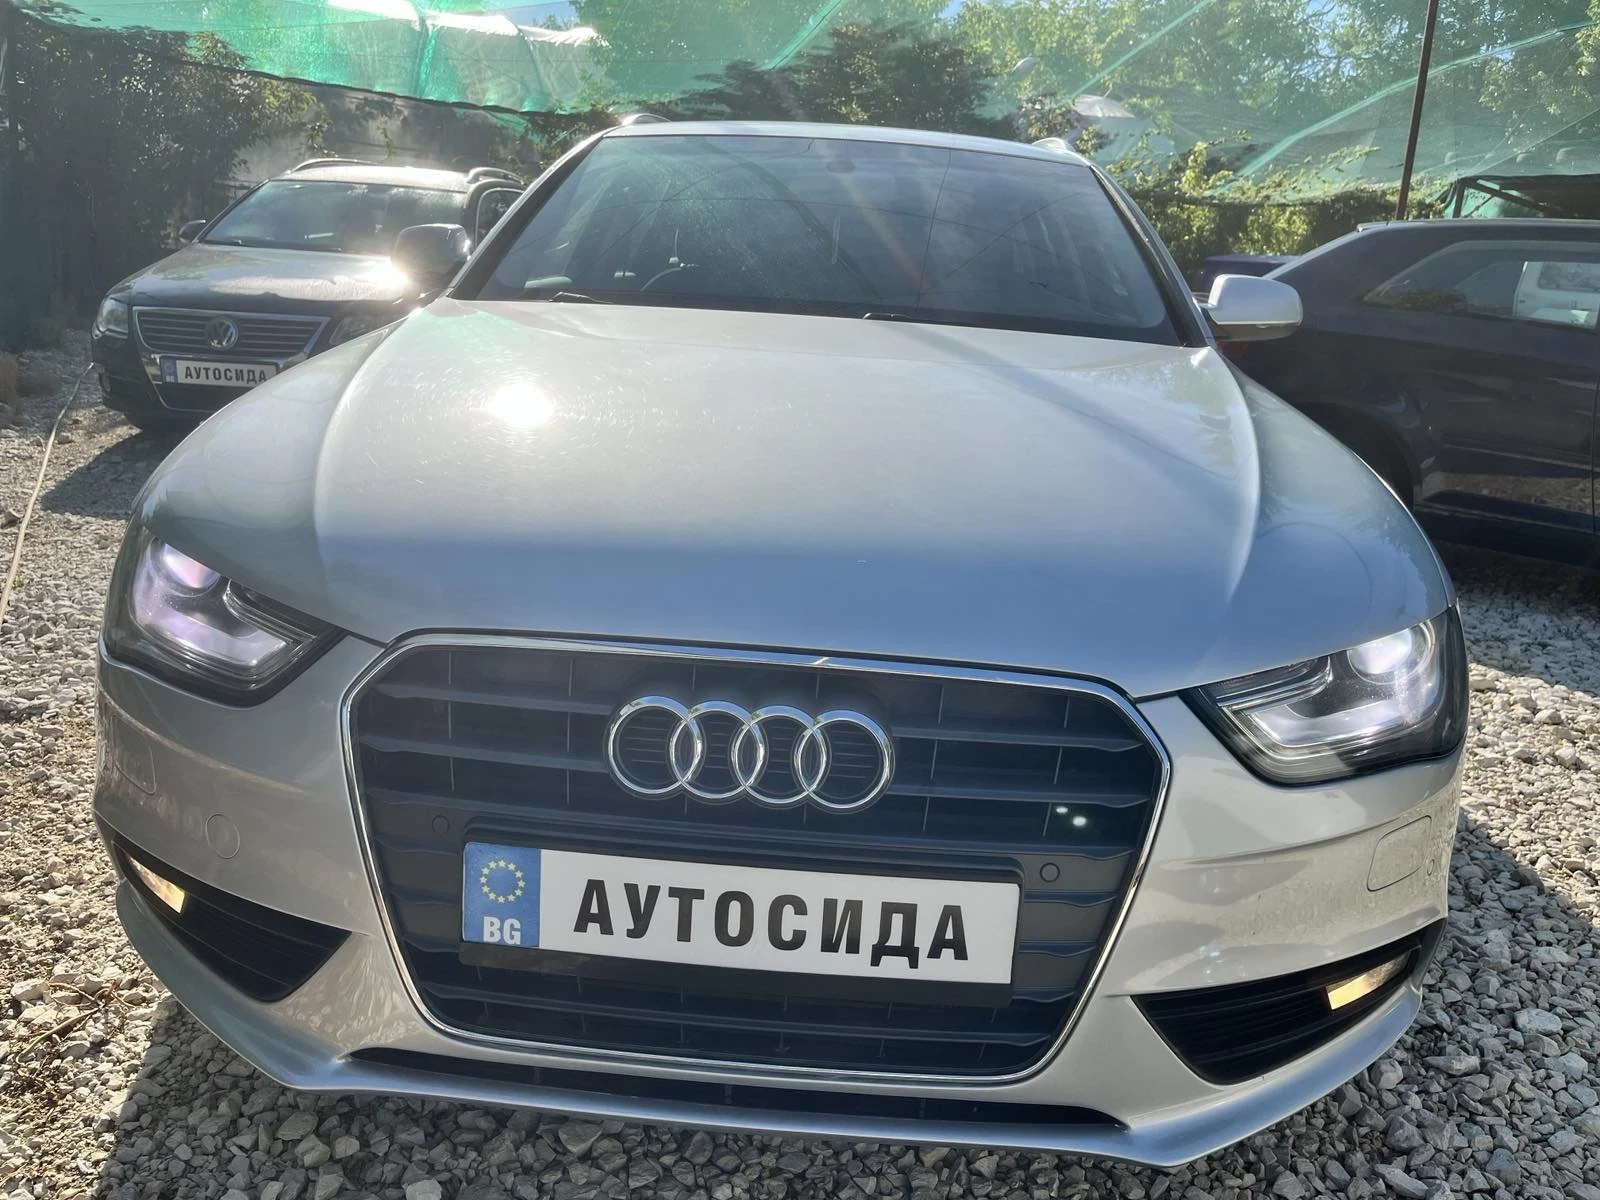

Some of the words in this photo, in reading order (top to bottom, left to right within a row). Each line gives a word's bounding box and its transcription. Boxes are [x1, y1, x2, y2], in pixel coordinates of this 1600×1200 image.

[185, 366, 267, 384] АУТОСИДА
[483, 916, 520, 945] BG
[573, 878, 969, 970] АУТОСИДА
